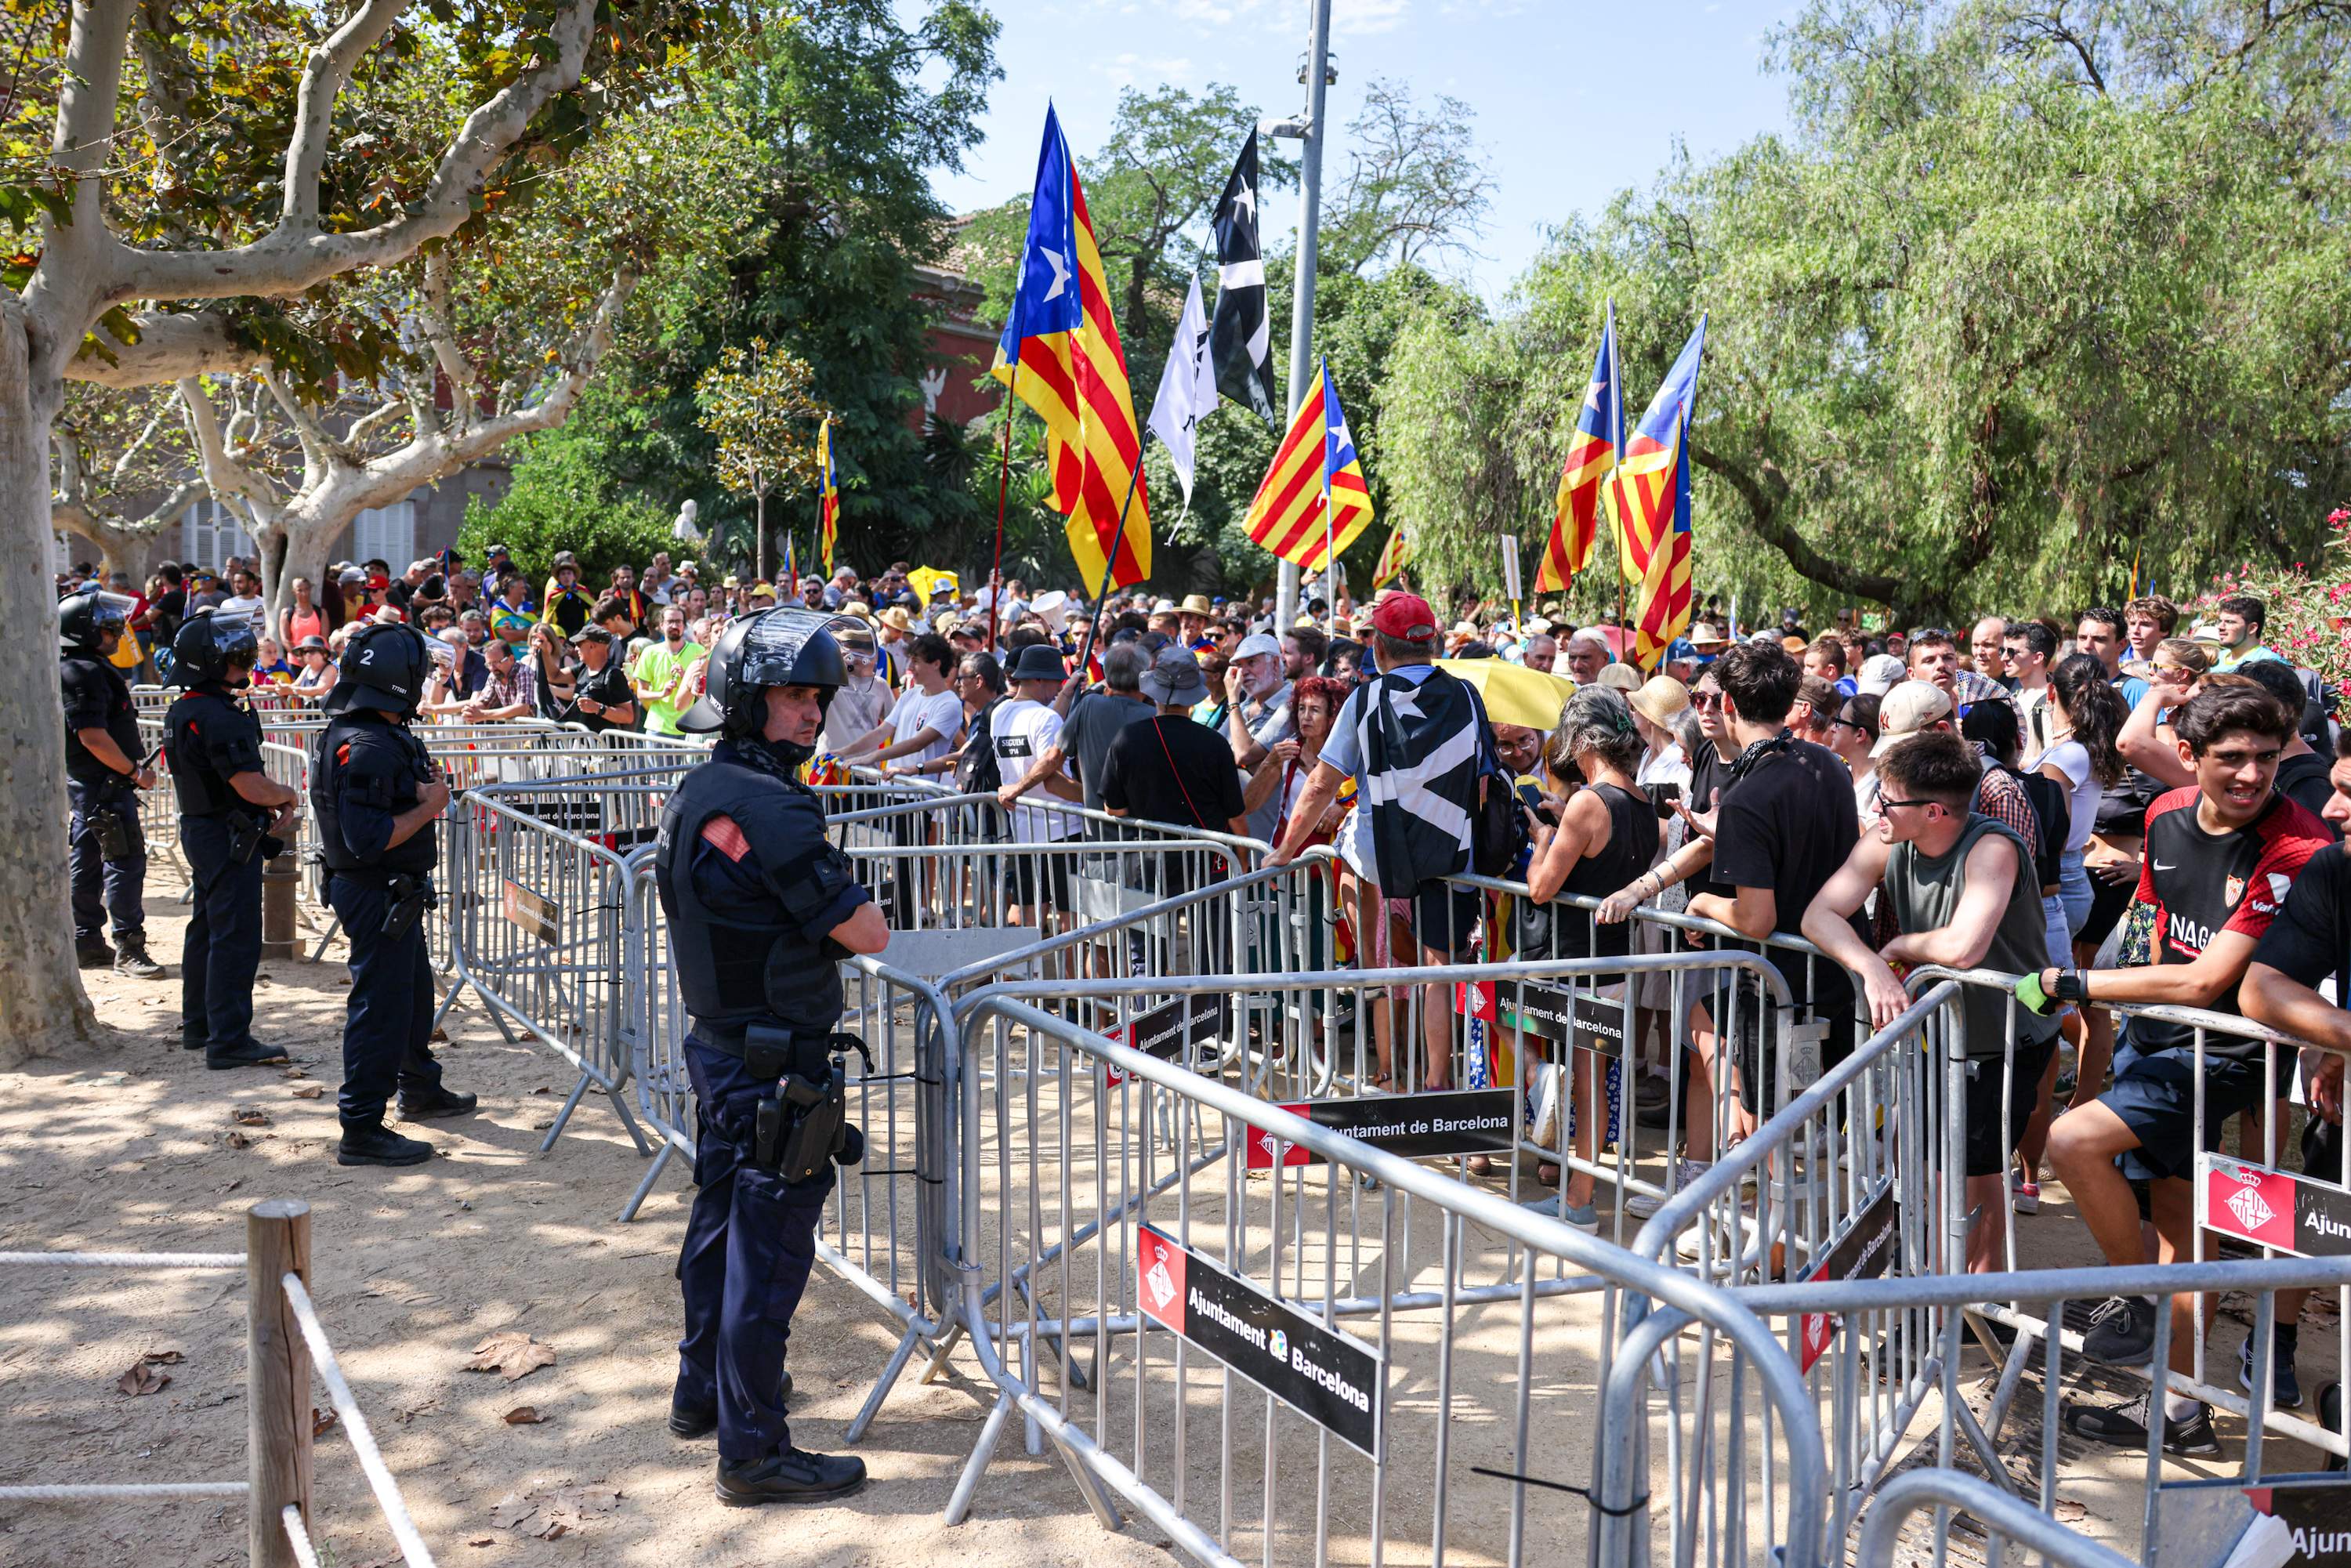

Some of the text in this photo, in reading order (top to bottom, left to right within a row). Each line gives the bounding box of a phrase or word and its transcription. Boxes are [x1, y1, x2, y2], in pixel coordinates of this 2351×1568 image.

[359, 649, 375, 666] 2
[1002, 737, 1024, 747] SEGUIM
[1139, 1006, 1219, 1053] Ajuntament de arcelona
[1555, 1012, 1567, 1024] de
[1410, 1120, 1429, 1134] de
[1433, 1115, 1509, 1133] Barcelona
[1867, 1220, 1893, 1258] Barcelona
[2304, 1211, 2351, 1239] Ajun
[1188, 1286, 1267, 1350] Ajuntament
[1291, 1346, 1370, 1413] Barcelona
[2292, 1526, 2351, 1559] Ajun
